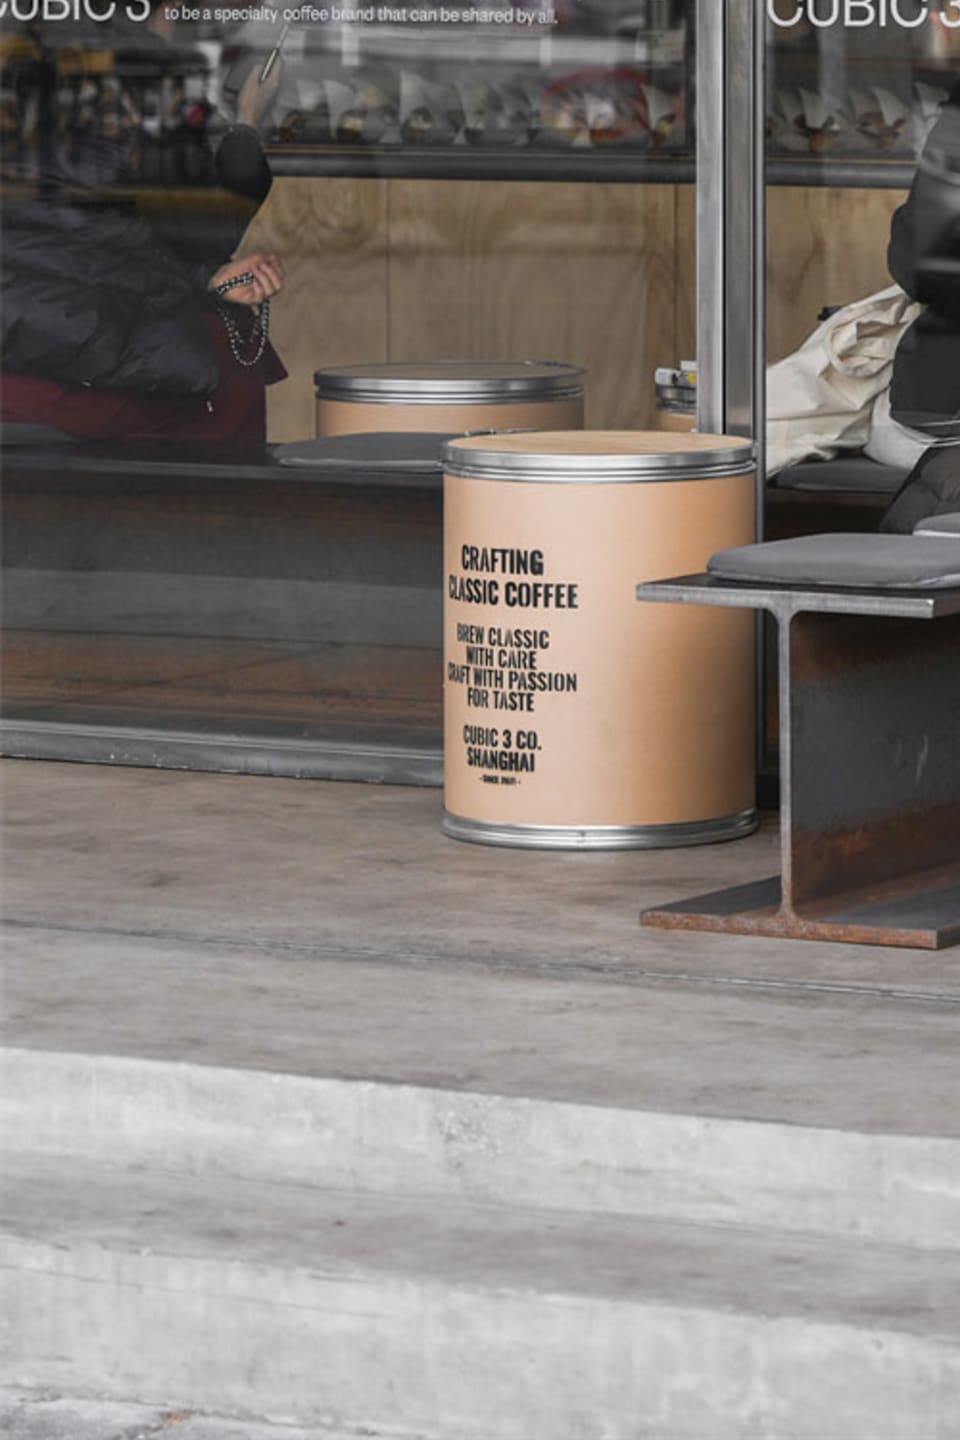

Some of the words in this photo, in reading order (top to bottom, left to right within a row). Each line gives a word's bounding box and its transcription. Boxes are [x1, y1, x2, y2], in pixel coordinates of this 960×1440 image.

[164, 6, 180, 20] to
[181, 5, 201, 20] be
[202, 9, 212, 21] a
[213, 5, 278, 24] specialty
[283, 6, 329, 21] coffee
[331, 5, 374, 21] brand
[377, 6, 406, 22] that
[409, 10, 438, 22] can
[440, 7, 459, 22] be
[461, 7, 514, 23] shared
[516, 7, 535, 26] by
[538, 8, 558, 24] all.
[461, 544, 544, 576] CRAFTING
[449, 574, 498, 606] CLASSIC
[505, 581, 578, 609] COFFEE
[457, 623, 484, 645] BREW
[488, 628, 549, 649] CLASSIC
[466, 645, 493, 667] WITH
[498, 649, 536, 670] CARE
[448, 662, 470, 685] CRAFT
[474, 666, 503, 689] WITH
[508, 671, 577, 692] PASSION
[467, 687, 489, 708] FOR
[493, 690, 534, 712] TASTE
[463, 724, 498, 747] CUBIC
[502, 729, 512, 749] 3
[516, 730, 542, 750] CO.
[467, 747, 535, 772] SHANGHAI
